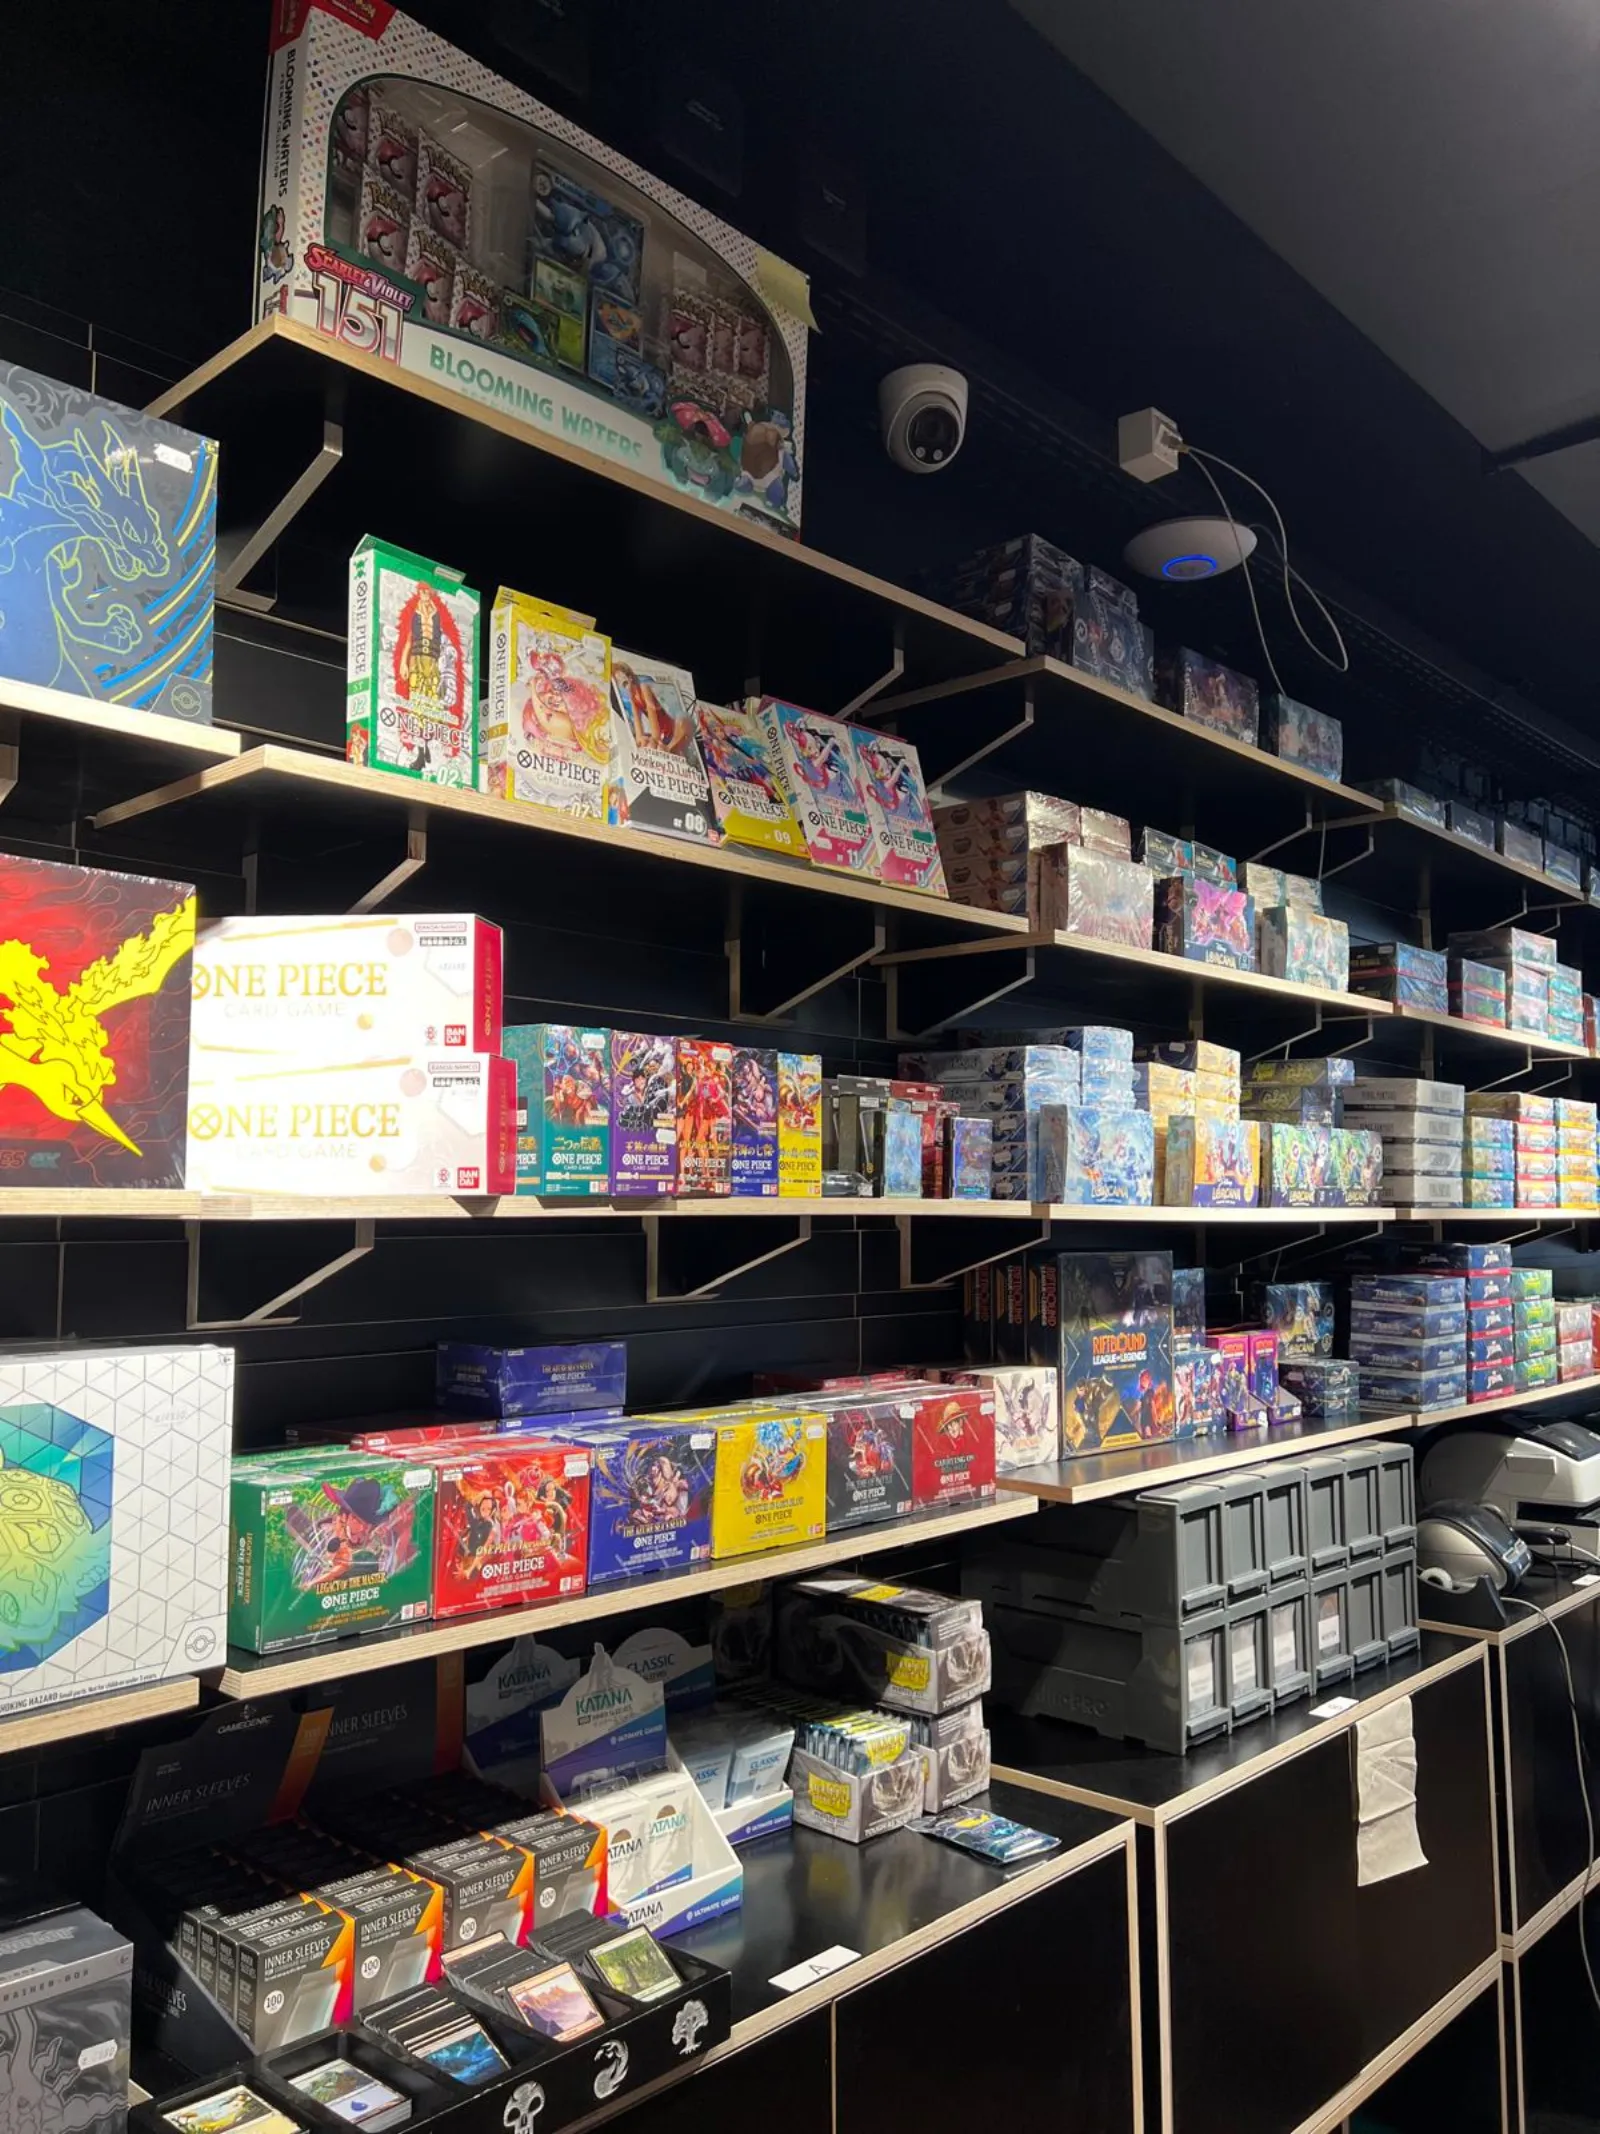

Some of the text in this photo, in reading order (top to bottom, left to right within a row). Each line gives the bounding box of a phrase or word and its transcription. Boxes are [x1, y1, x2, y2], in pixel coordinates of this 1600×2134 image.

[278, 48, 296, 198] BLOOMING WATERS
[307, 246, 366, 285] SCARLET
[367, 271, 414, 309] VIOLET
[312, 270, 404, 366] 151
[429, 344, 554, 422] BLOOMING
[561, 405, 643, 457] WATERS
[354, 581, 368, 675] ONE PIECE
[494, 632, 507, 720] ONE PIECE
[380, 707, 470, 751] ONE PIECE
[517, 749, 601, 786] ONE PIECE
[767, 726, 791, 793] ONE PIECE
[436, 767, 459, 787] 02
[630, 767, 709, 800] ONE PIECE
[570, 802, 590, 819] 07
[719, 791, 790, 820] ONE PIECE
[684, 812, 705, 833] 08
[808, 811, 868, 838] ONE PIECE
[773, 829, 792, 844] 09
[880, 831, 937, 857] ONE PIECE
[191, 961, 389, 1000] ONE PIECE
[224, 1002, 347, 1019] CARD GAME
[188, 1103, 400, 1141] ONE PIECE
[551, 1152, 603, 1165] ONE PIECE
[621, 1153, 670, 1166] ONE PIECE
[683, 1157, 726, 1168] ONE PIECE
[731, 1159, 773, 1171] ONE PIECE
[1092, 1331, 1148, 1354] RIFTBOUND
[1092, 1354, 1116, 1366] LEAGUE
[939, 1471, 971, 1485] ONE PIECE
[852, 1486, 886, 1502] ONE PIECE
[755, 1508, 793, 1525] ONE PIECE
[633, 1530, 677, 1550] ONE PIECE
[482, 1556, 545, 1579] ONE PIECE
[315, 1579, 340, 1595] LEGACY
[320, 1586, 380, 1610] ONE PIECE
[628, 1653, 675, 1674] CLASSIC
[498, 1666, 551, 1690] KATANA
[0, 1699, 28, 1713] HOKING
[28, 1691, 58, 1707] HAZARD
[575, 1688, 633, 1716] KATANA
[328, 1703, 408, 1738] NNER SLEEVES
[696, 1766, 719, 1780] ASSIC
[749, 1755, 781, 1770] CLASSIC
[145, 1772, 252, 1813] INNER SLEEVES
[651, 1813, 688, 1836] ATANA
[539, 1841, 591, 1868] INNER SLEEVES
[608, 1838, 643, 1860] ATANA
[459, 1869, 515, 1898] INNER SLEEVES
[541, 1890, 555, 1904] 100
[694, 1894, 740, 1917] ULTIMATE GUARD
[361, 1903, 422, 1934] INNER SLEEVES
[627, 1900, 664, 1925] ATANA
[461, 1920, 475, 1935] 100
[264, 1935, 331, 1970] INNER SLEEVES
[363, 1960, 379, 1974] 100
[3, 1979, 55, 2001] RAINER
[265, 1993, 282, 2009] 100
